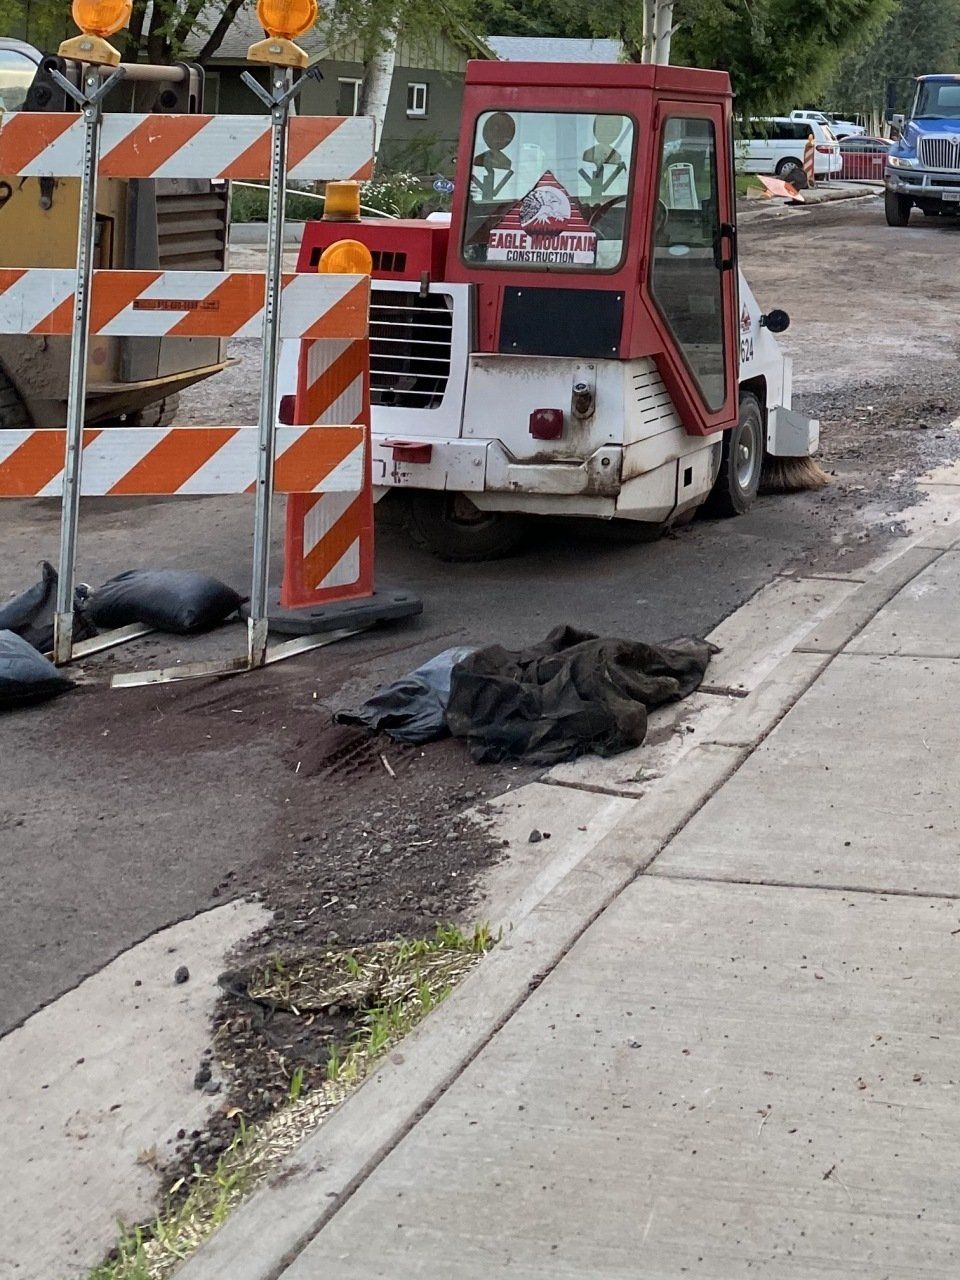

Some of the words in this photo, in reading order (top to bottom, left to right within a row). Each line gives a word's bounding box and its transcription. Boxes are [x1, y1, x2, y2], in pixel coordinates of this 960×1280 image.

[490, 232, 527, 250] EAGLE
[531, 234, 596, 251] MOUNTAIN
[506, 250, 575, 263] CONSTRUCTION
[740, 337, 754, 363] 624
